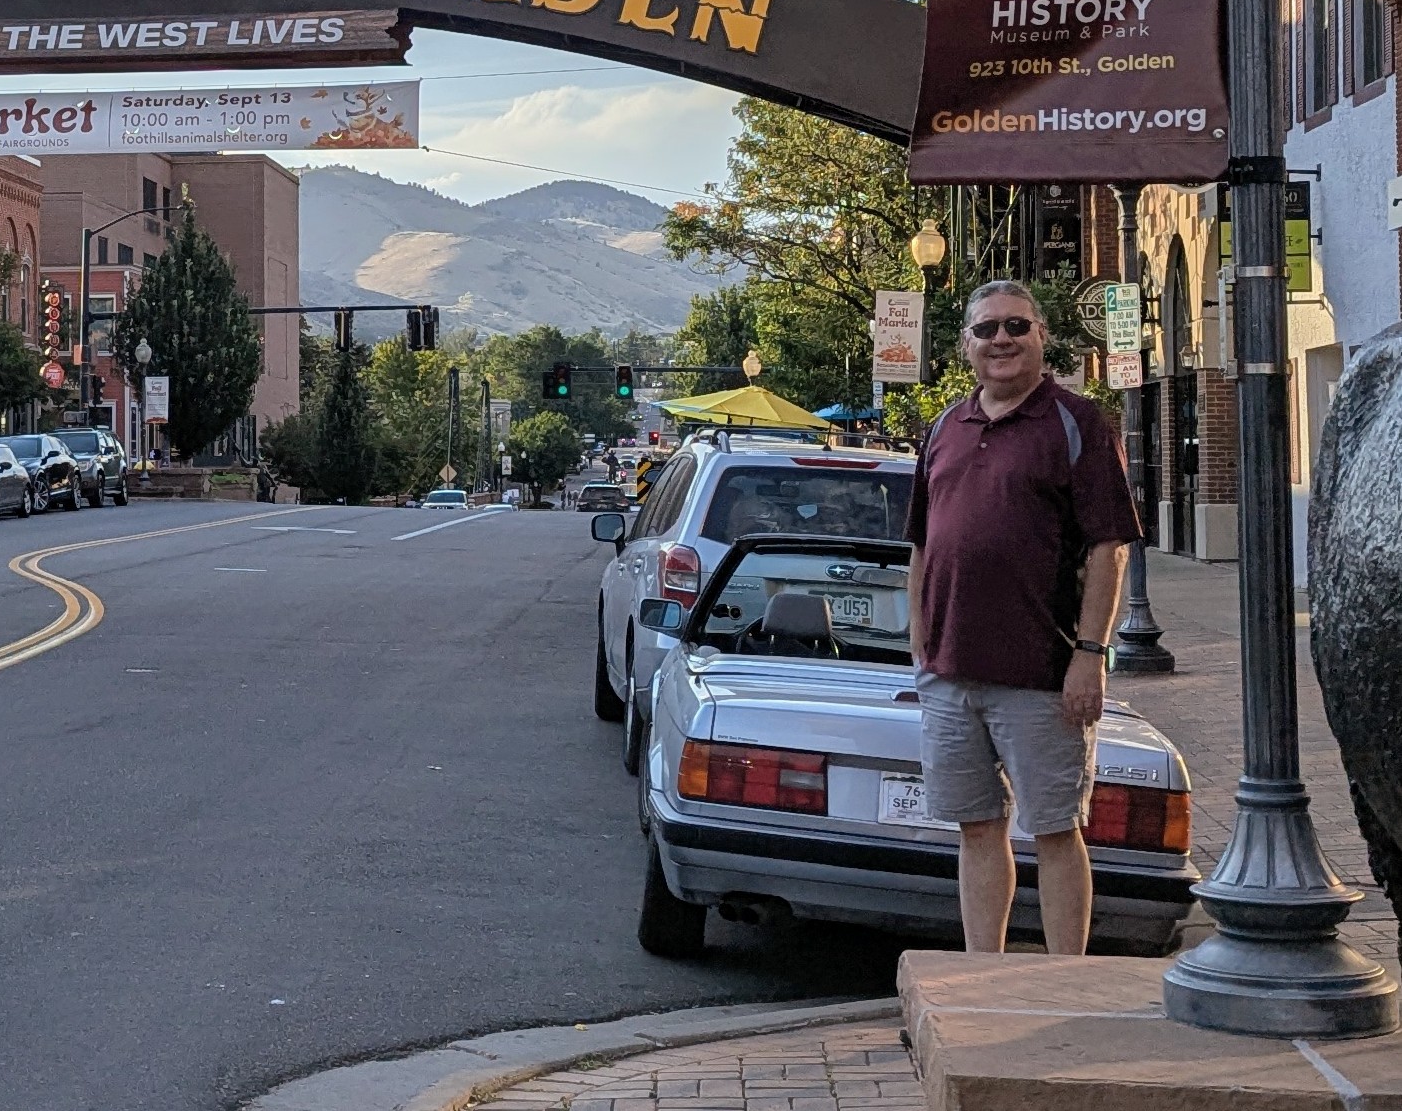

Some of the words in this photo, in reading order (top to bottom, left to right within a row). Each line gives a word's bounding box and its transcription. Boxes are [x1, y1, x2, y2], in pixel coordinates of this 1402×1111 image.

[2, 24, 86, 50] THE
[98, 22, 218, 48] WEST
[227, 18, 345, 45] LIVES
[990, 28, 1070, 44] Museum
[1079, 26, 1091, 39] &
[1101, 23, 1150, 38] Park
[969, 59, 1005, 78] 923
[1011, 57, 1052, 75] 10th
[1058, 57, 1091, 76] St.,
[1098, 53, 1175, 73] Golden
[122, 95, 209, 109] Saturday,
[217, 93, 261, 108] Sept
[270, 92, 292, 104] 13
[121, 112, 169, 127] 10:00
[174, 116, 199, 126] am
[220, 111, 257, 126] 1:00
[263, 113, 290, 129] pm
[931, 108, 1206, 133] GoldenHistory.org
[122, 131, 288, 145] foothillsanimalshelter.org
[1107, 291, 1116, 308] 2
[888, 307, 909, 317] Fall
[878, 317, 918, 328] Market
[905, 785, 925, 797] 76
[893, 798, 917, 809] SEP
